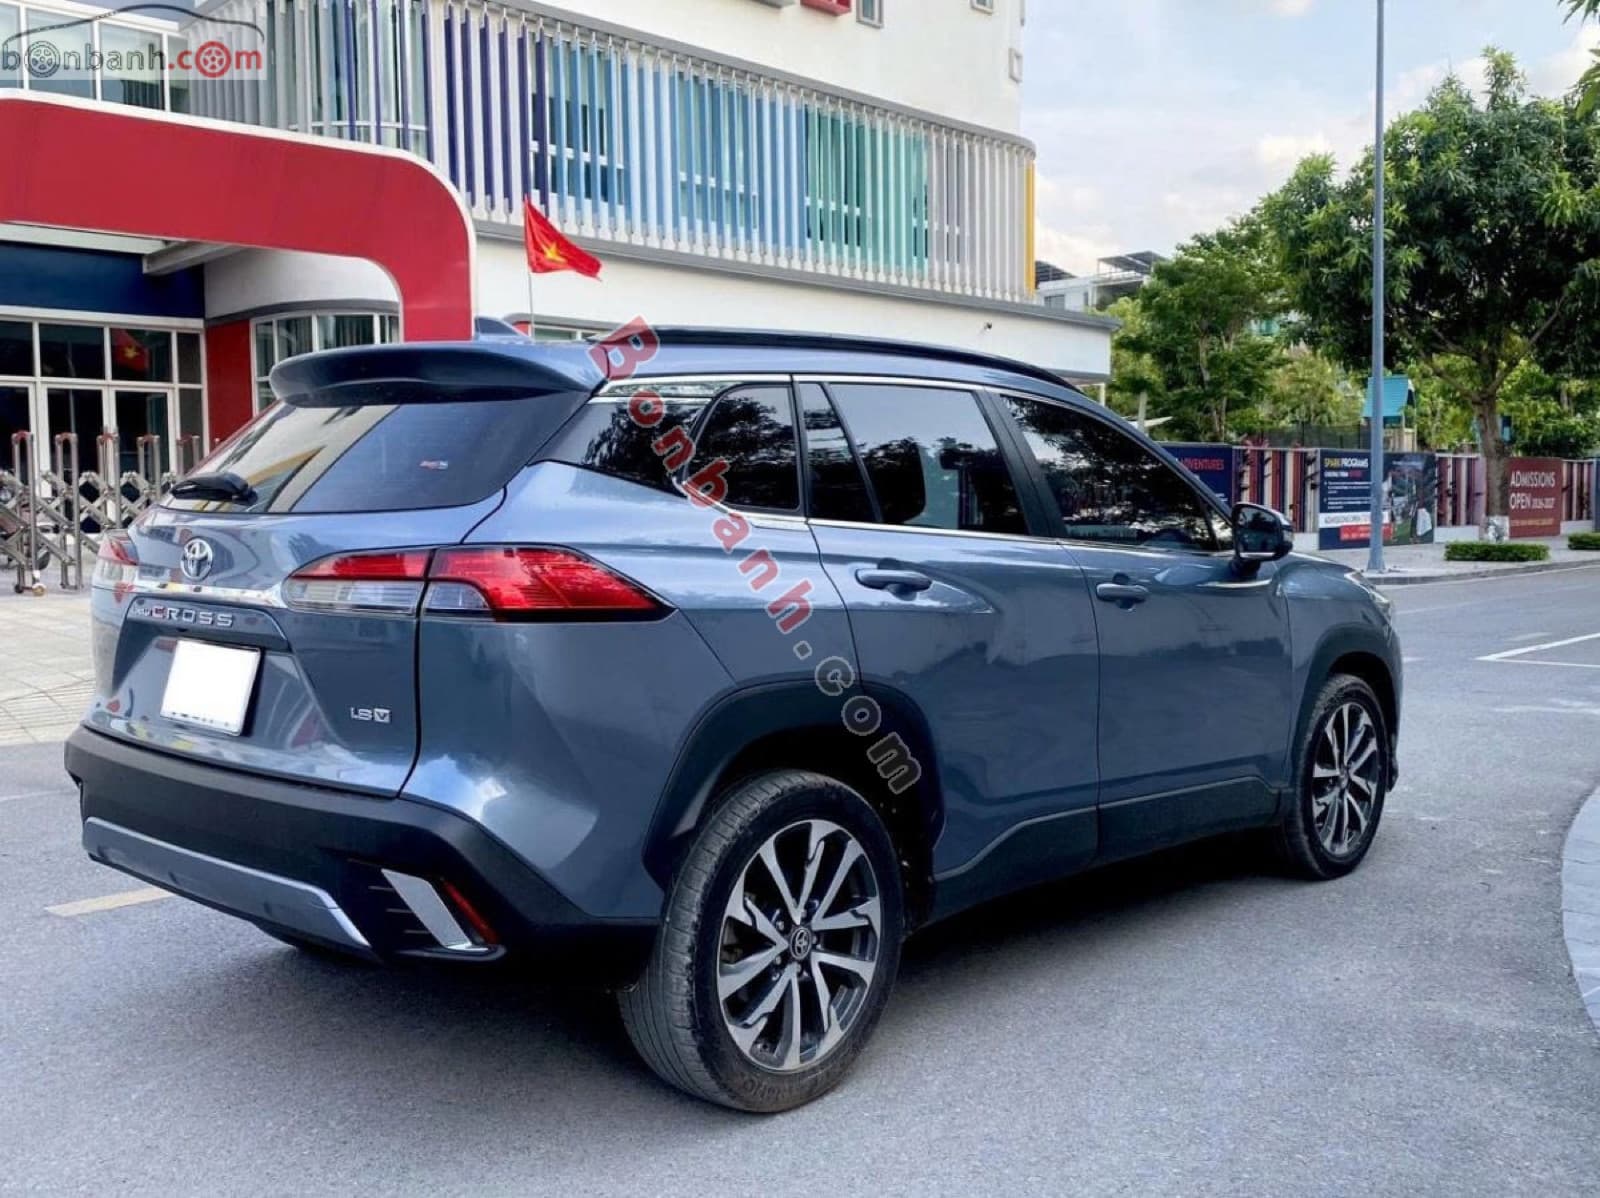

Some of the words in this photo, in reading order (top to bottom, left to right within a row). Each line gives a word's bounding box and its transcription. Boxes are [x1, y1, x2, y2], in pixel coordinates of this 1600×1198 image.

[1511, 470, 1555, 487] ADMISSIONS
[1510, 493, 1530, 509] OPEN
[152, 605, 233, 627] CROSS
